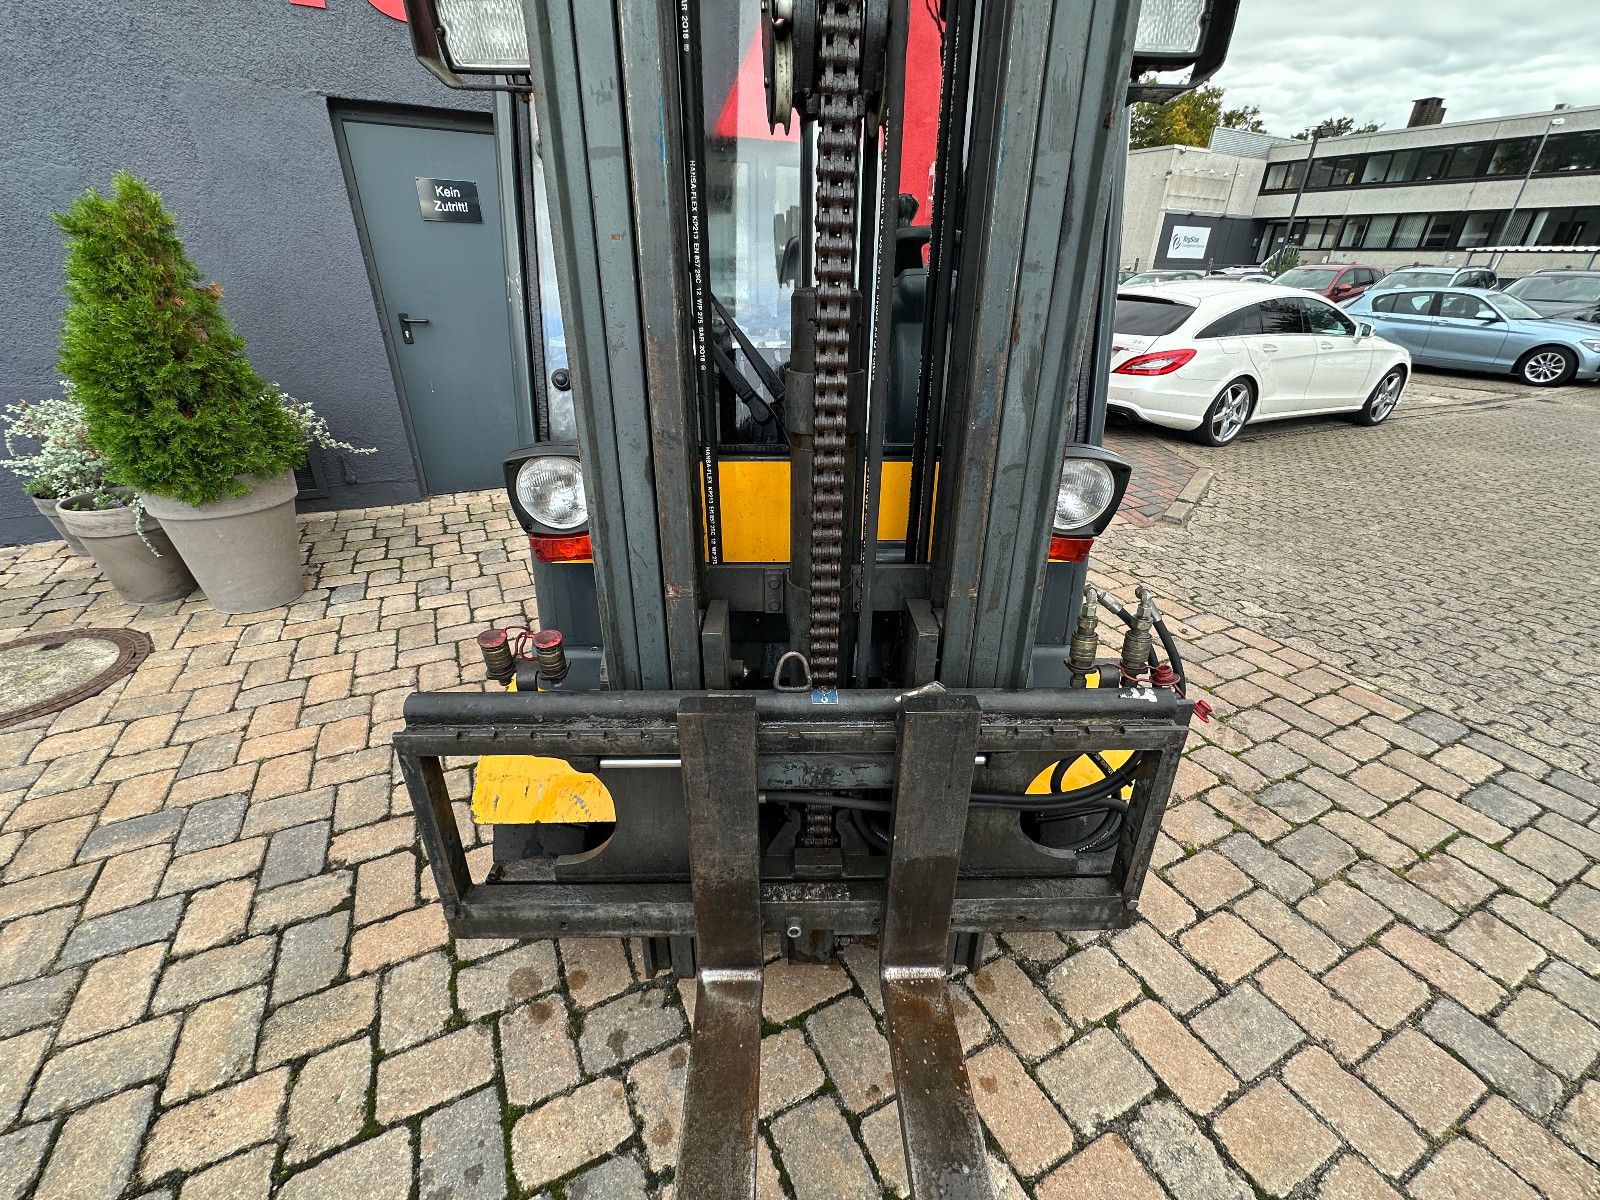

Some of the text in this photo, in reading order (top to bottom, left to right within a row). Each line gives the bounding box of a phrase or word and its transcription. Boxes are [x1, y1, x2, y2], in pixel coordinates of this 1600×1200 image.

[434, 186, 460, 198] Kein
[433, 200, 469, 212] Zutritt!
[694, 242, 699, 254] EN
[697, 298, 702, 310] WP
